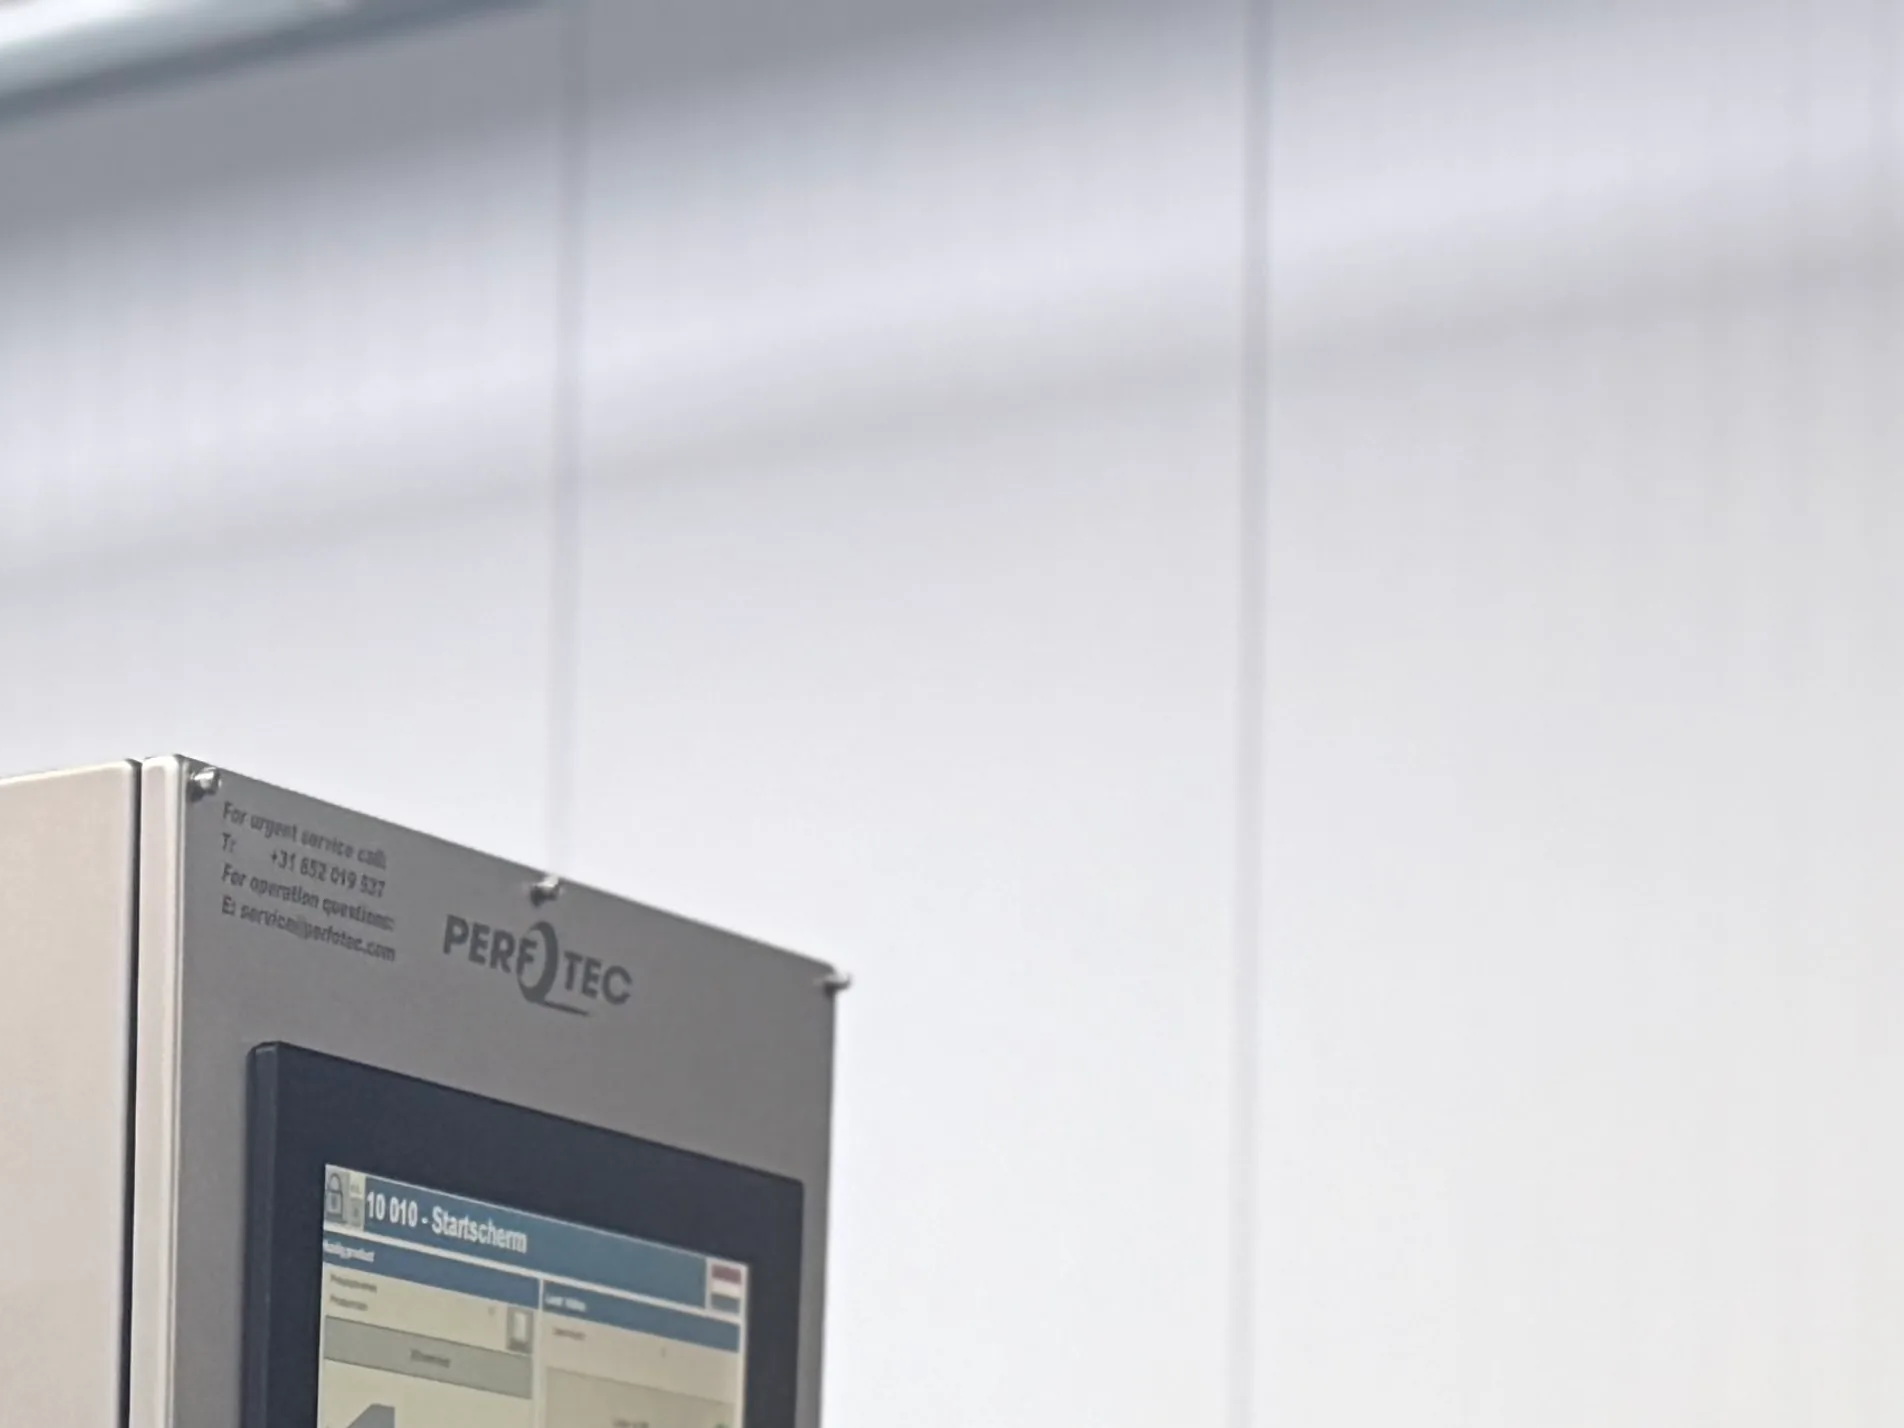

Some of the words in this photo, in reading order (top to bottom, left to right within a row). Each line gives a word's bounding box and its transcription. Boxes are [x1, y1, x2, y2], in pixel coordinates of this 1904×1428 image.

[223, 801, 247, 826] For
[249, 815, 298, 842] urgent
[301, 829, 354, 858] service
[222, 862, 247, 887] For
[249, 876, 320, 909] operation
[271, 848, 296, 872] +31
[443, 913, 635, 1007] PERFOTEC
[366, 1190, 386, 1222] 10
[388, 1195, 418, 1229] 010
[431, 1205, 528, 1255] Startscherm
